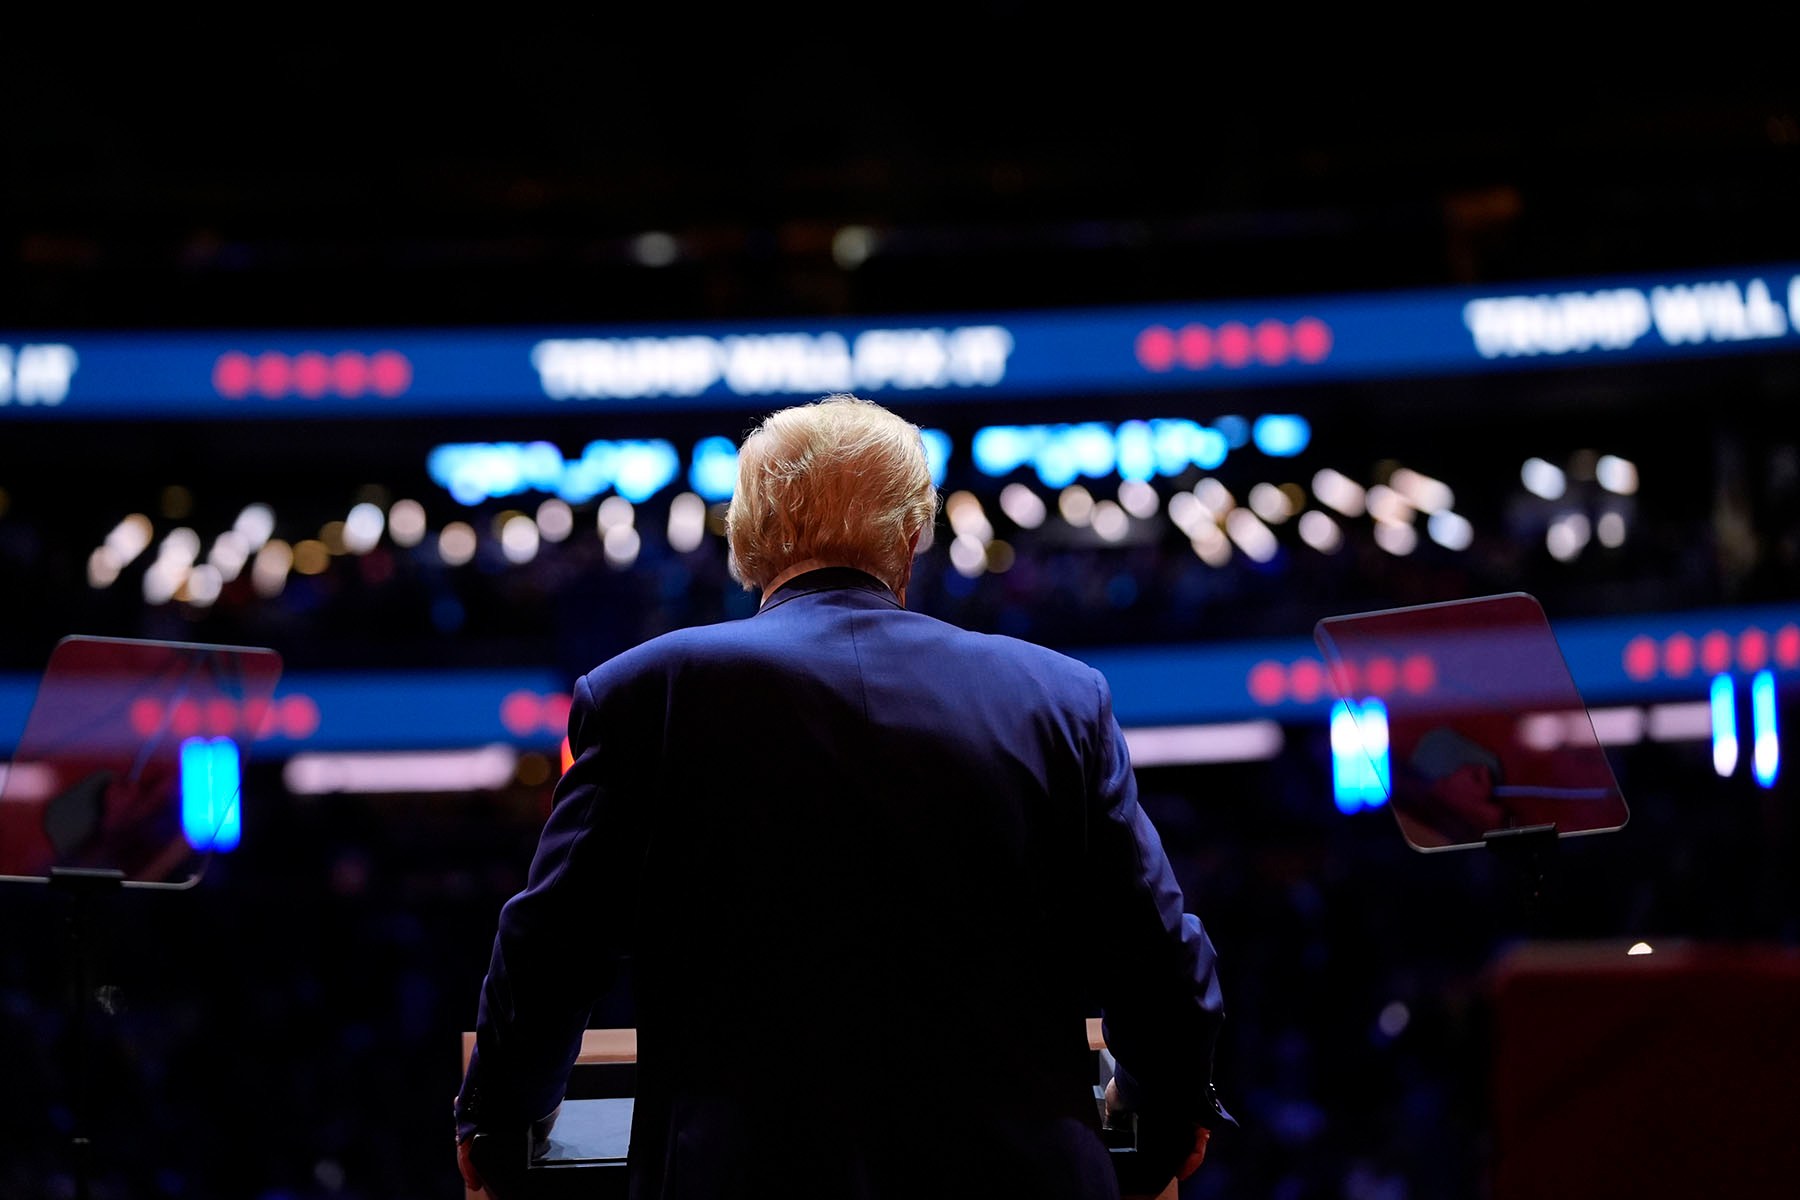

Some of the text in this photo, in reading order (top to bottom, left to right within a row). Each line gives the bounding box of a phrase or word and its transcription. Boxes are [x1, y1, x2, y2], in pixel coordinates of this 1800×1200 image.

[1462, 288, 1650, 359] TRUMP
[1650, 278, 1788, 346] WILL
[531, 336, 722, 399] TRUMP
[722, 331, 852, 395] WILL
